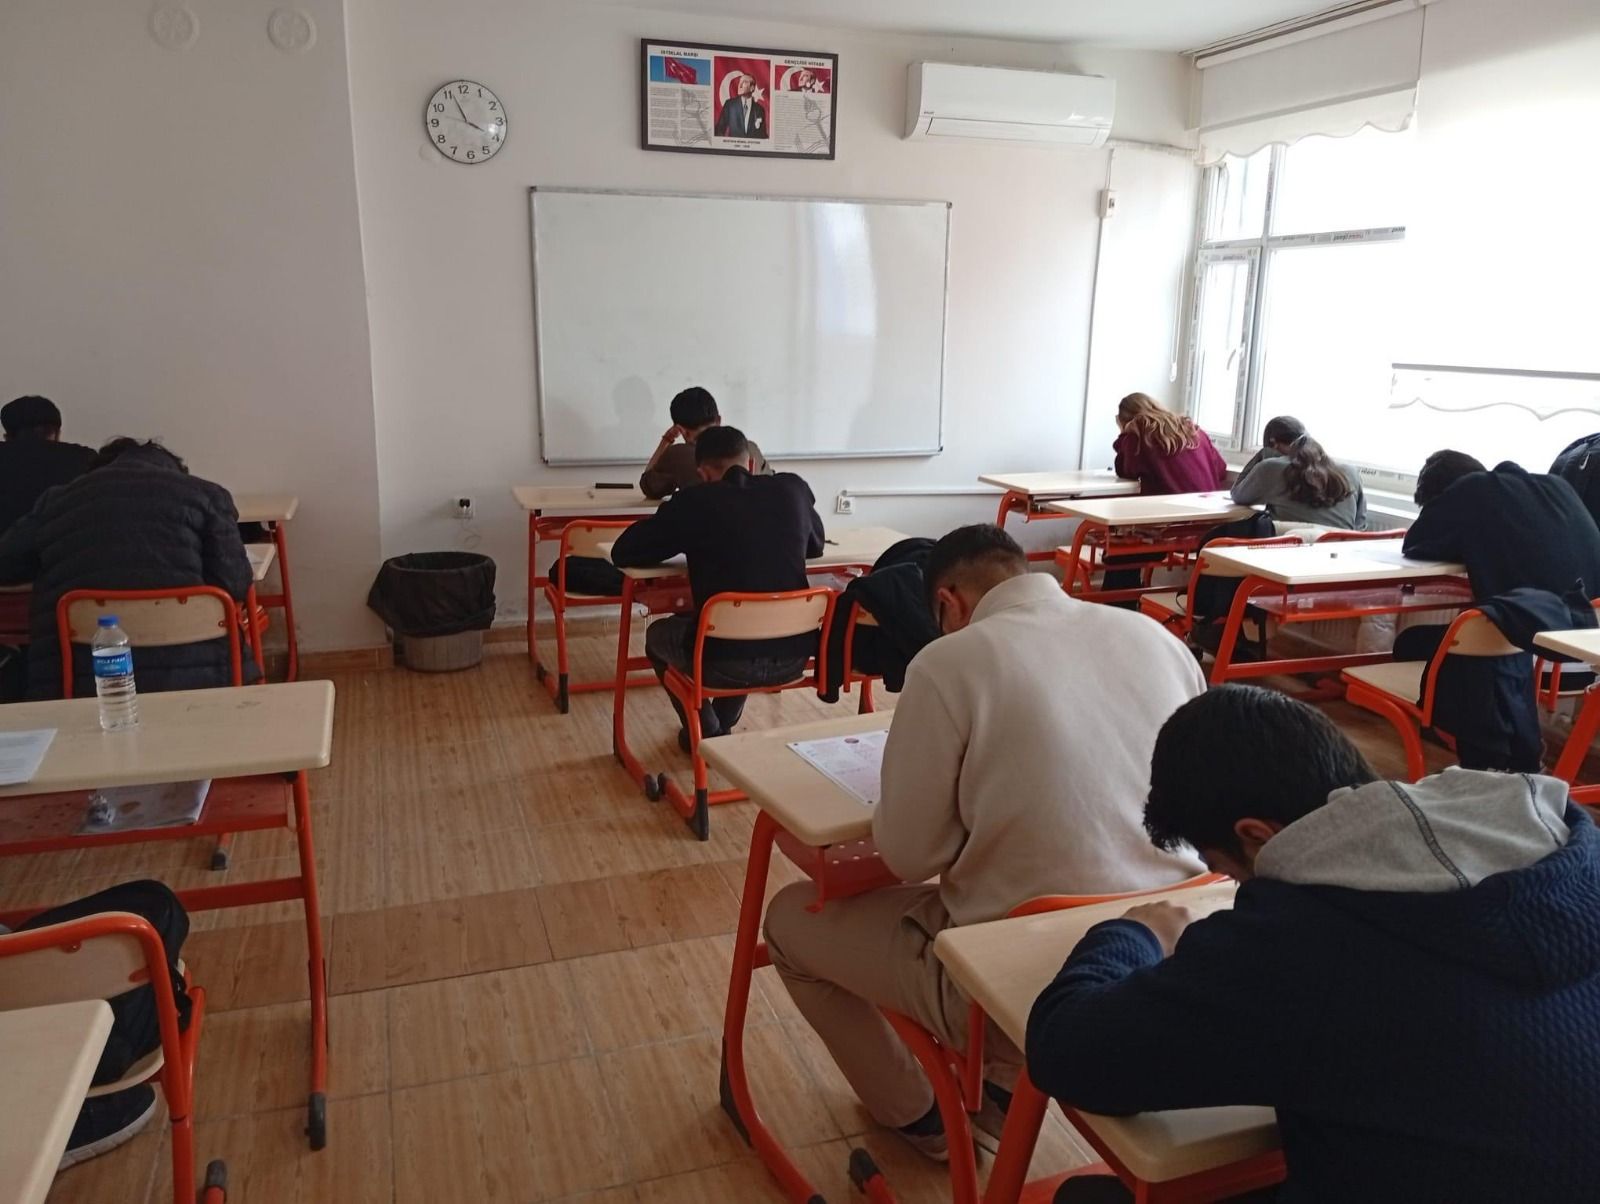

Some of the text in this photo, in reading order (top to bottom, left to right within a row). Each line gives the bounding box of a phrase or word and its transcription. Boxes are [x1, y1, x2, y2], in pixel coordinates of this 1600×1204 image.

[458, 85, 469, 94] 12
[477, 88, 482, 98] 1
[443, 90, 453, 100] 11
[433, 103, 445, 113] 10
[488, 101, 497, 111] 2
[431, 118, 440, 128] 9
[495, 117, 504, 127] 3
[437, 134, 446, 144] 8
[450, 146, 458, 155] 7
[466, 150, 475, 160] 6
[482, 145, 491, 155] 5
